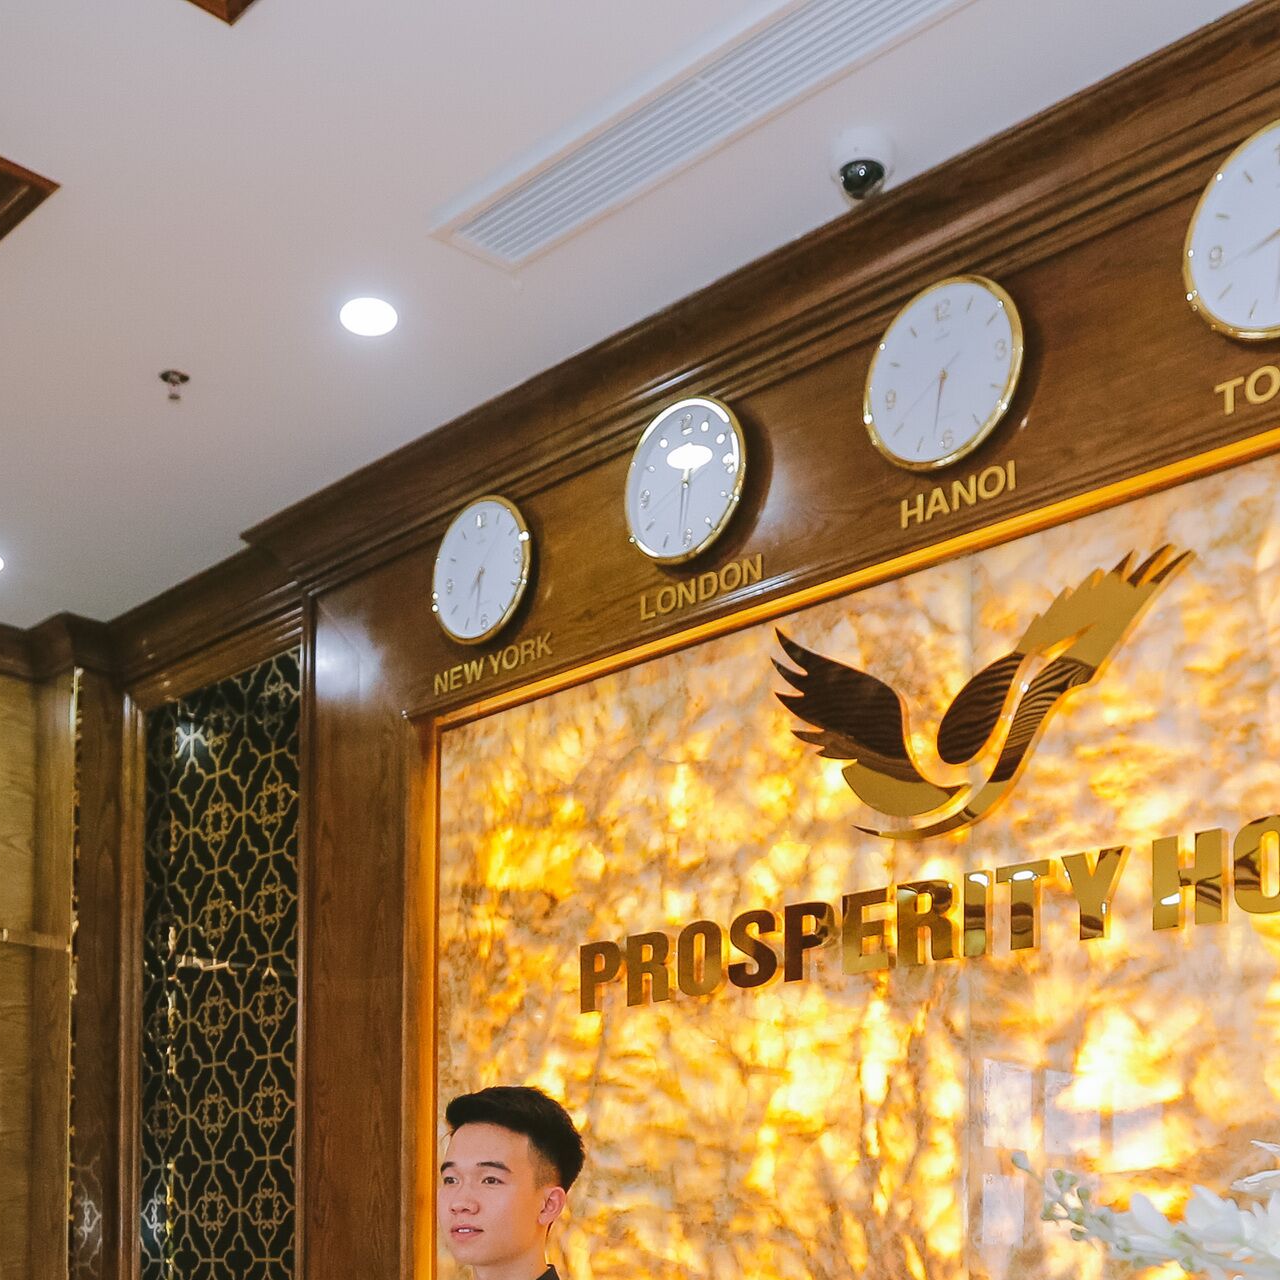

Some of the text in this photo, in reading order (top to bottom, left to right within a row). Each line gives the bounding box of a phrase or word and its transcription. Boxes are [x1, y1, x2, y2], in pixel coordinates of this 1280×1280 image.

[1207, 244, 1224, 270] 9
[934, 298, 951, 322] 12
[994, 337, 1008, 361] 3
[884, 388, 897, 411] 9
[941, 428, 954, 451] 6
[900, 460, 1018, 529] HANOI
[640, 553, 764, 620] LONDON
[480, 613, 489, 630] 6
[434, 632, 553, 696] NEW YORK
[580, 845, 1130, 1014] PROSPERITY
